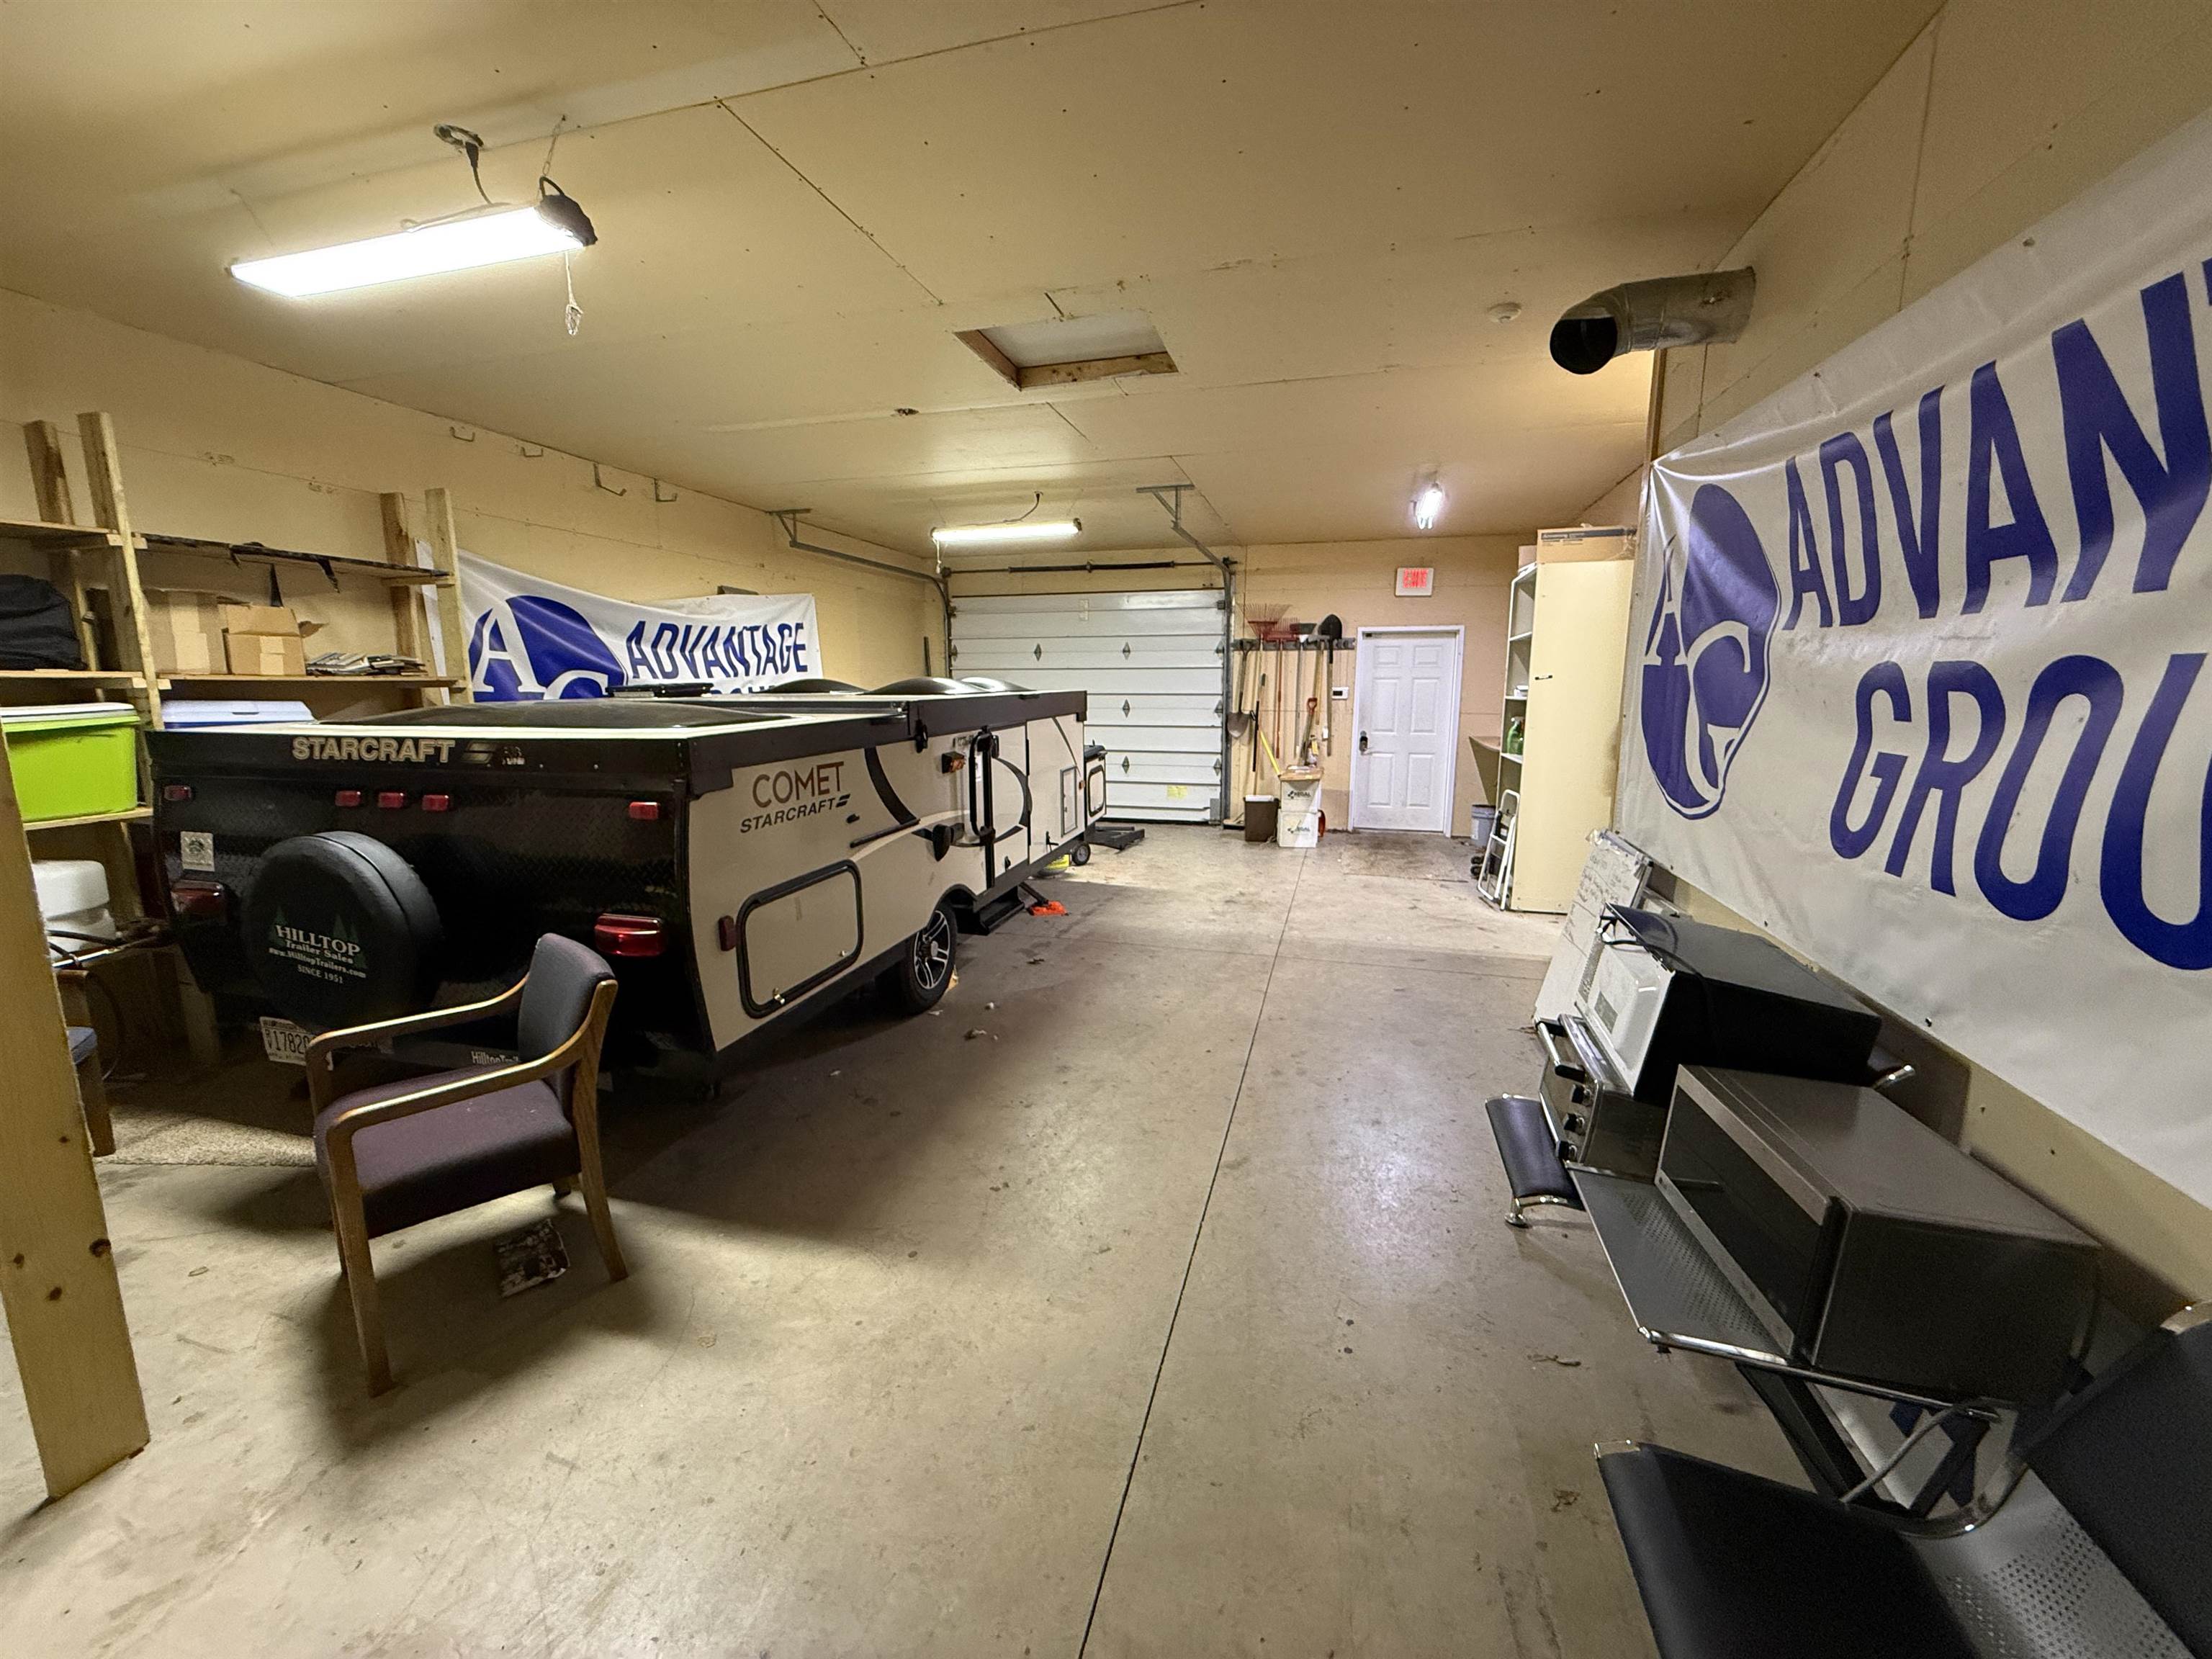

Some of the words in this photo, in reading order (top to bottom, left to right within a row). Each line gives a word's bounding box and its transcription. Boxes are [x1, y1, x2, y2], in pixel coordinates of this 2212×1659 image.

[1781, 257, 2212, 631] ADVAN
[626, 620, 808, 679] ADVANTAGE
[292, 737, 456, 763] STARCRAFT
[752, 761, 844, 808] COMET
[740, 797, 835, 833] STARCRAFT
[276, 925, 360, 956] HILLTOP
[285, 939, 320, 955] Trailer
[323, 949, 354, 964] Sales
[297, 964, 322, 978] SINCE
[323, 971, 343, 984] 1951
